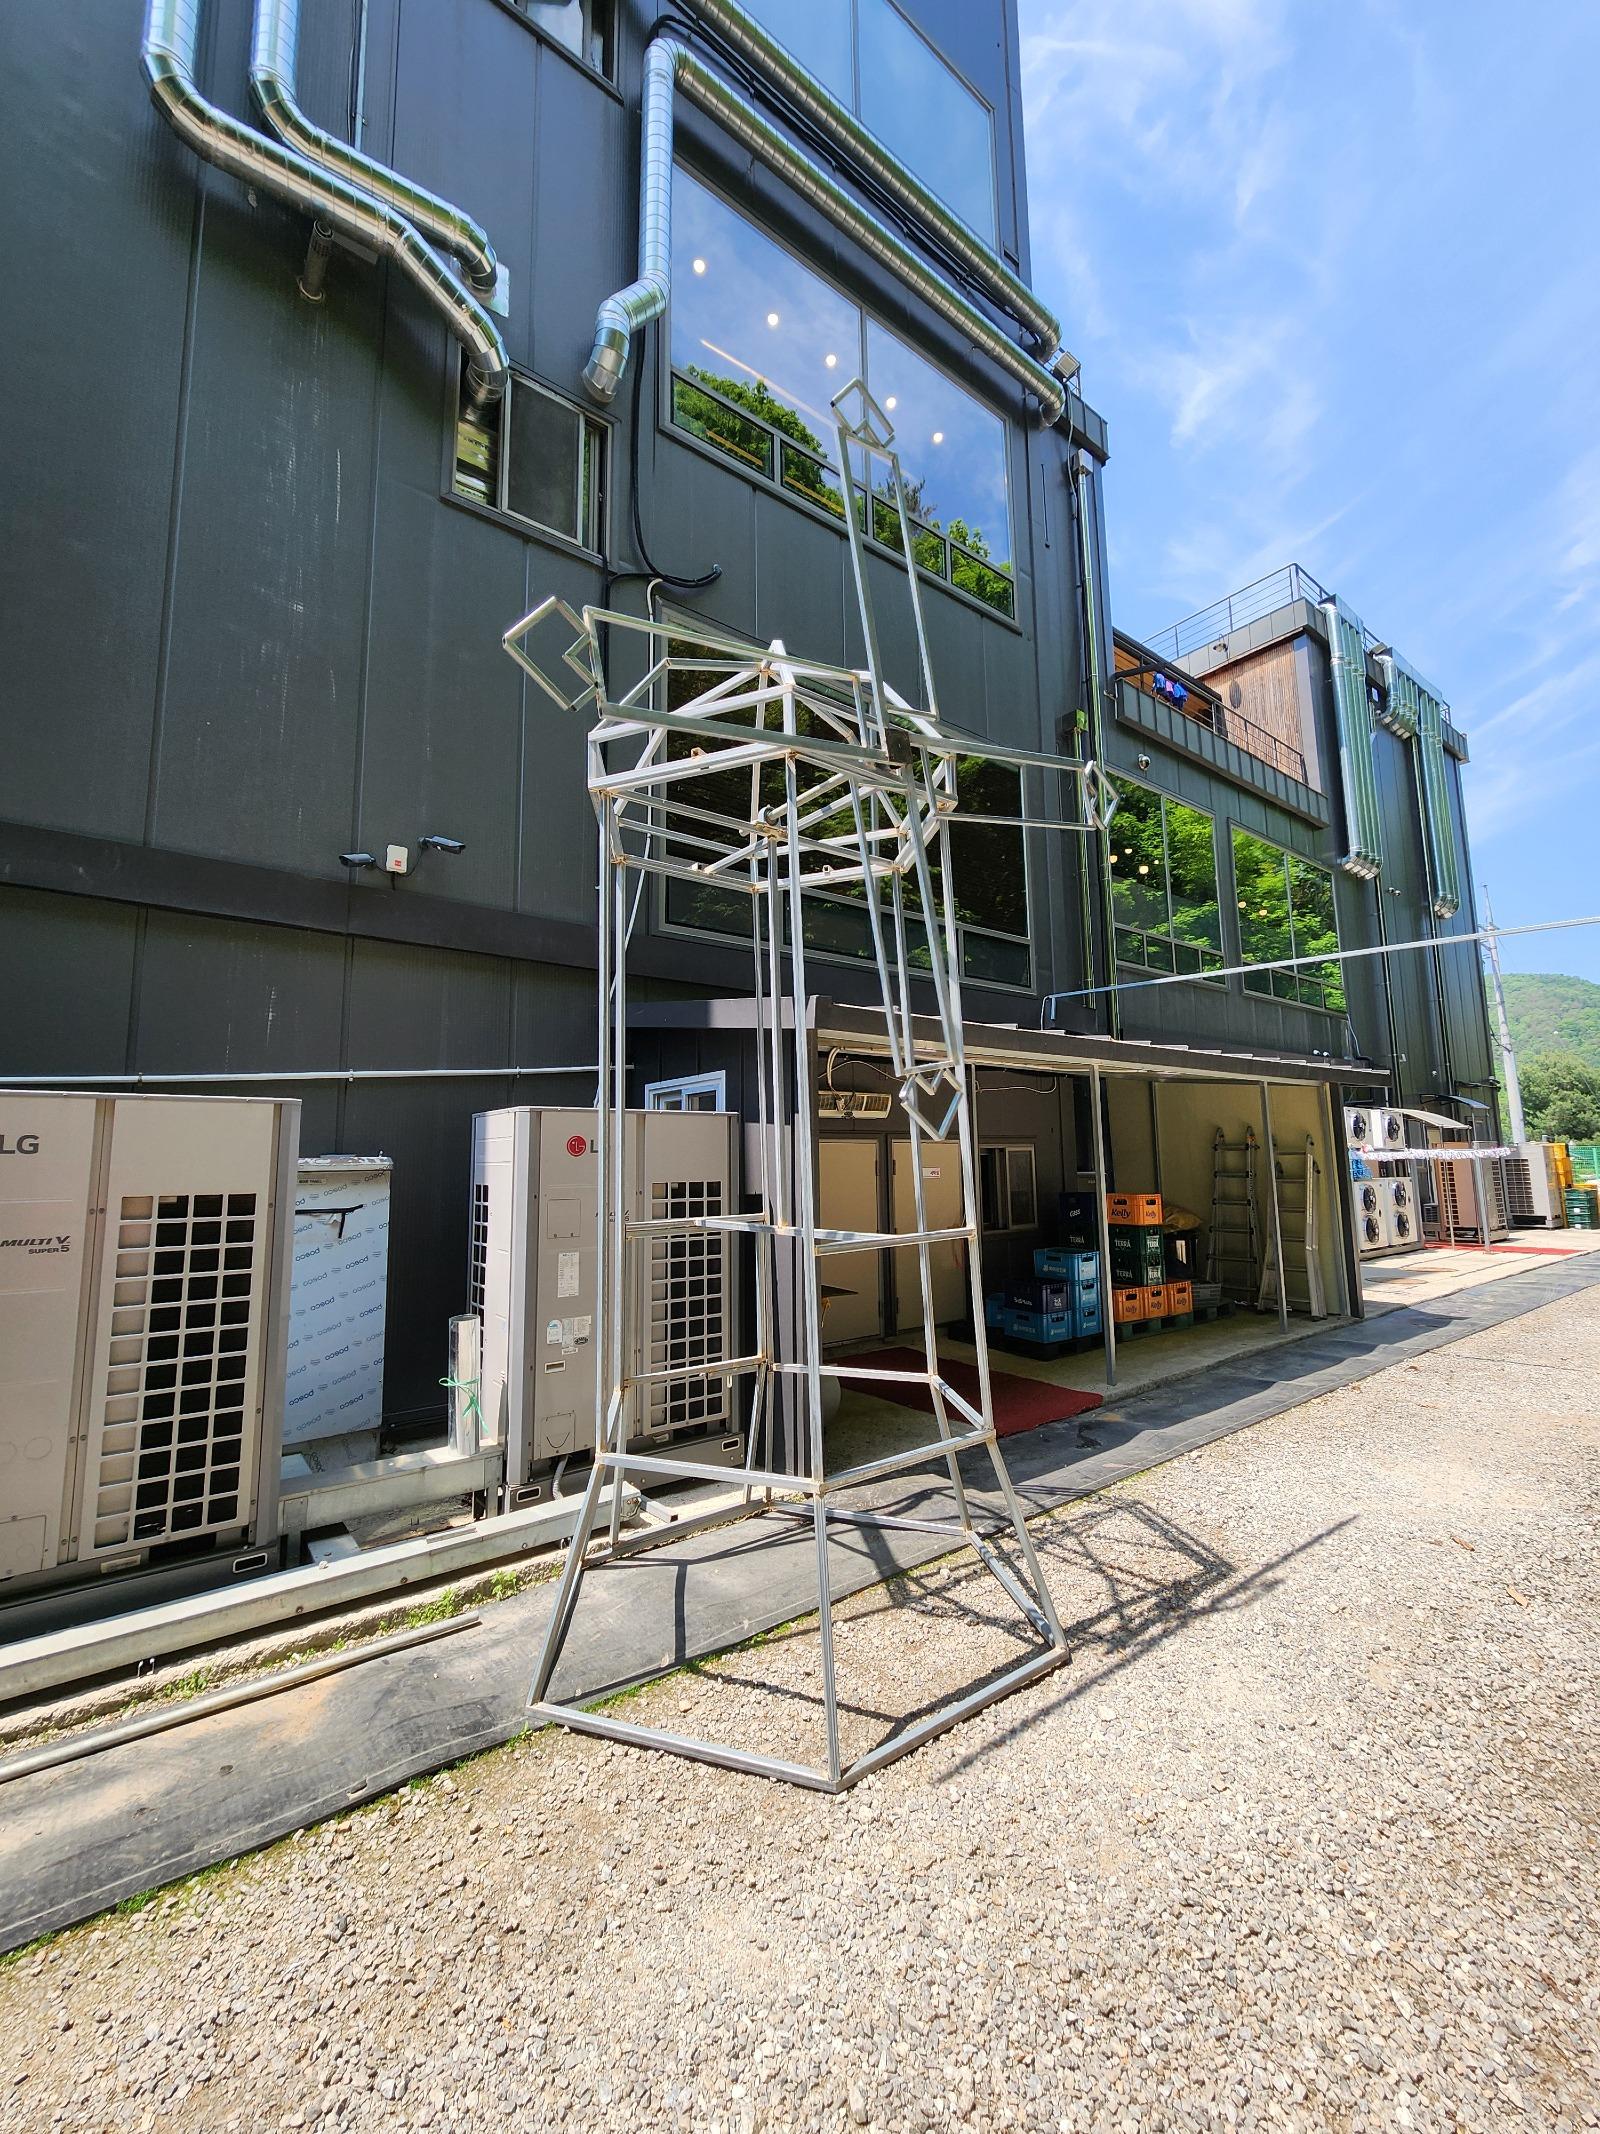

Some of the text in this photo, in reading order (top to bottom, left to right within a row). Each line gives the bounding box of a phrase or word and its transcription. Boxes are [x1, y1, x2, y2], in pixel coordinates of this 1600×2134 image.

[0, 1134, 39, 1154] LG
[1111, 1207, 1131, 1218] Kelly
[0, 1238, 52, 1247] MULTI
[1115, 1239, 1132, 1248] TERRA
[295, 1248, 320, 1261] posco
[345, 1255, 369, 1269] posco
[303, 1272, 328, 1287] posco
[352, 1280, 376, 1293] posco
[310, 1296, 335, 1311] posco
[359, 1304, 383, 1318] posco
[317, 1322, 342, 1336] posco
[325, 1345, 349, 1360] posco
[332, 1369, 357, 1385] posco
[288, 1389, 315, 1406] posco
[339, 1393, 364, 1410] posco
[296, 1414, 322, 1431] posco
